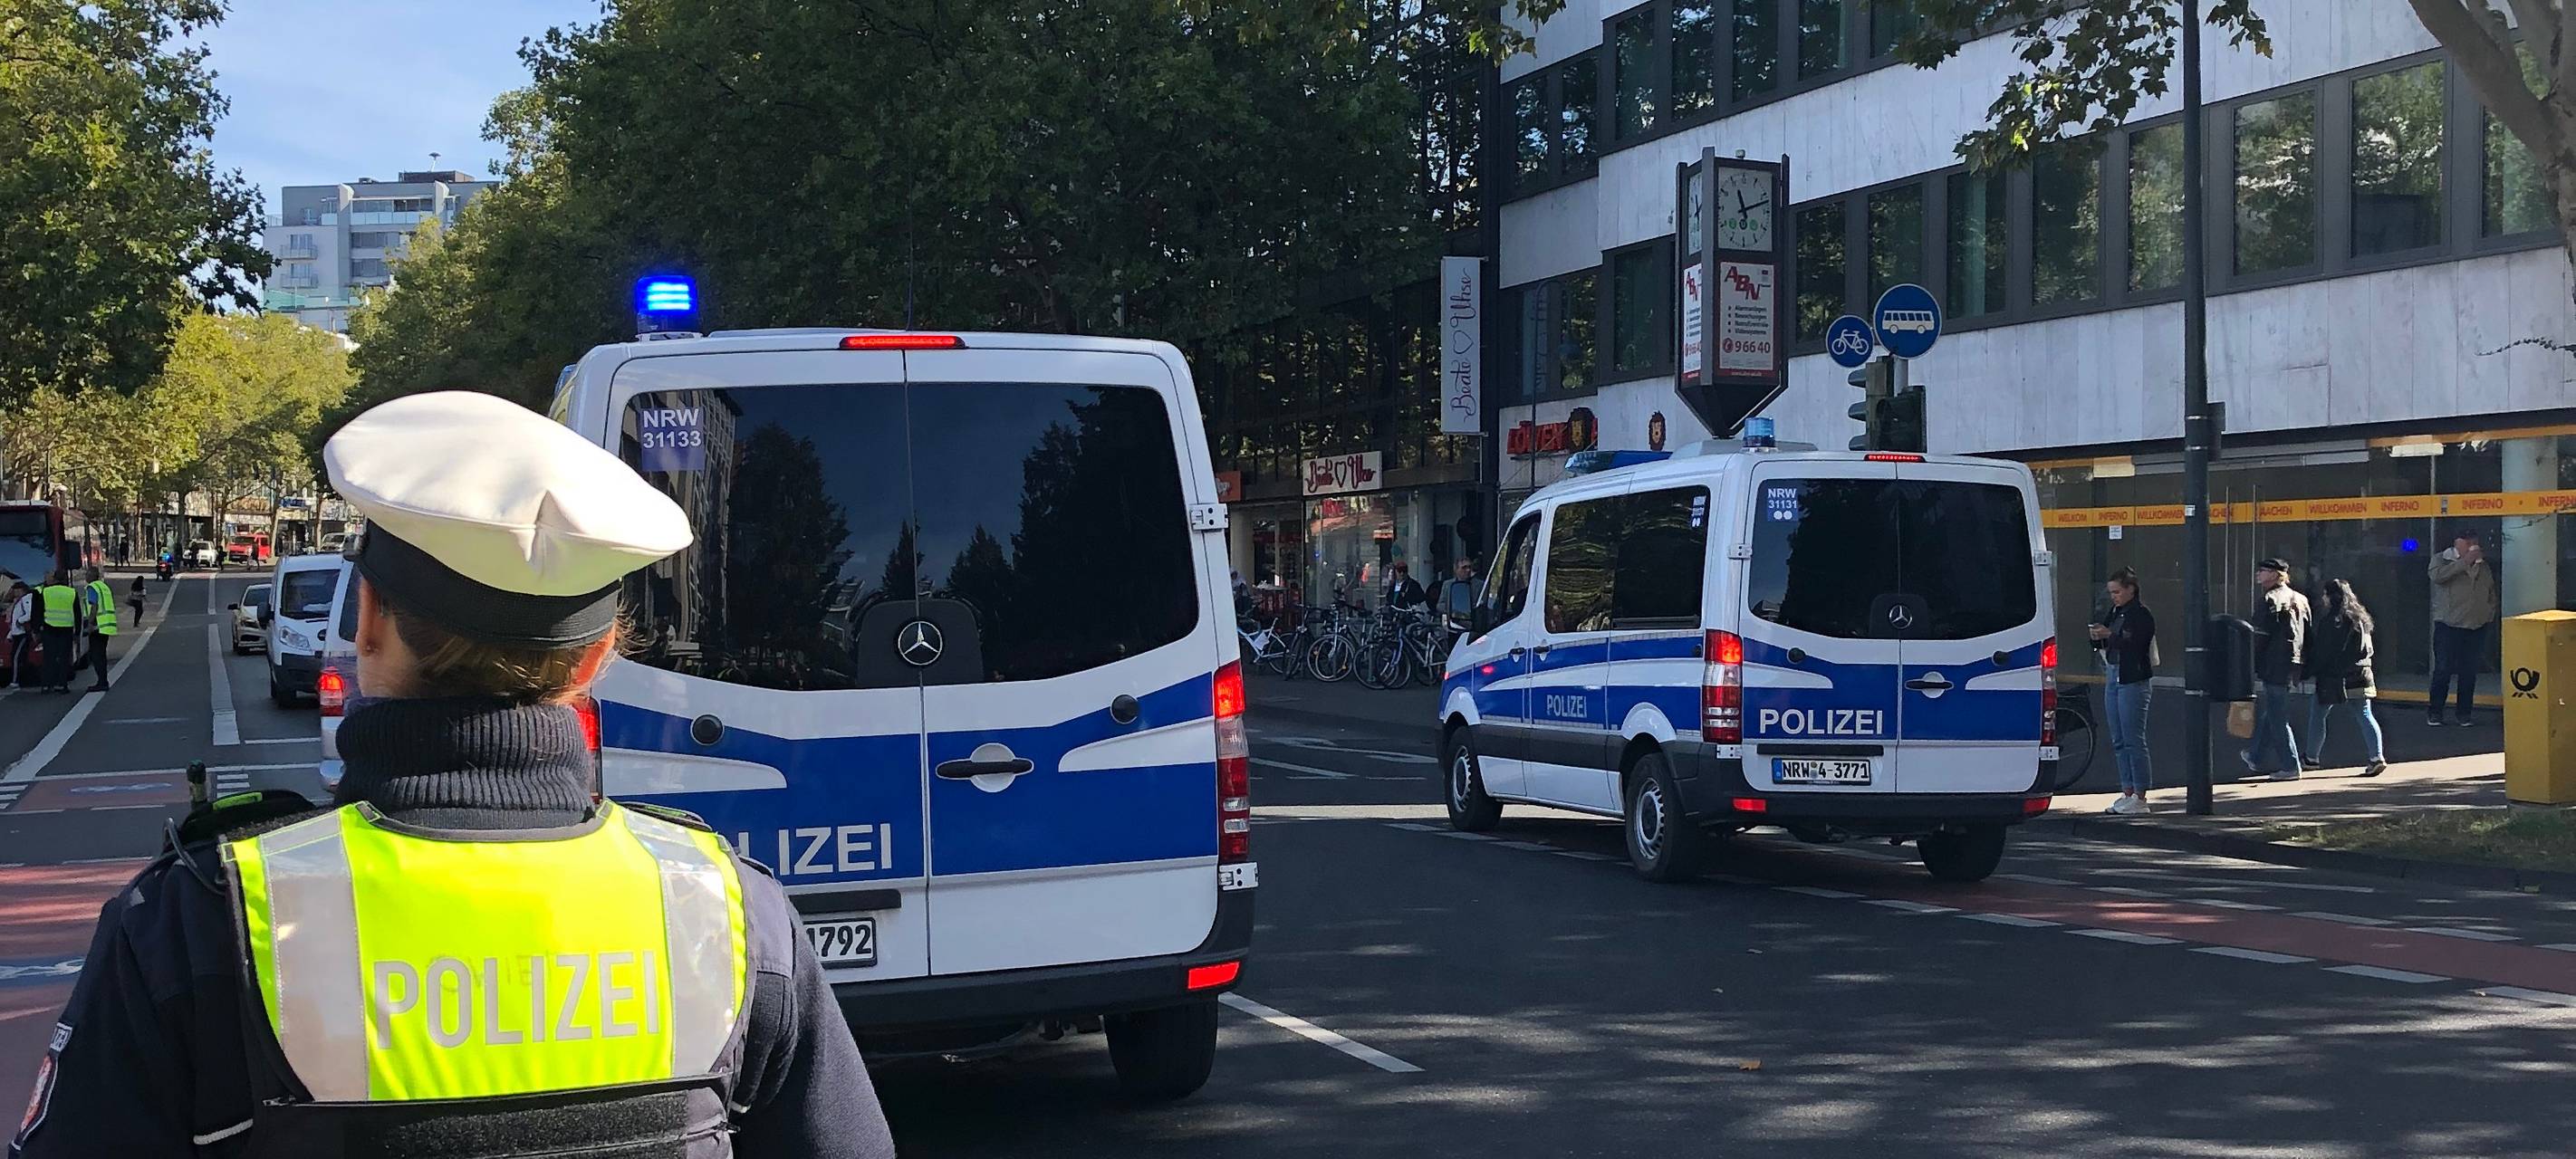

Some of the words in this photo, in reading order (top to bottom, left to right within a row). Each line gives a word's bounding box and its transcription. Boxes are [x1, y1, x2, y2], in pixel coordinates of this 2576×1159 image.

[1724, 265, 1761, 301] ABN
[1450, 267, 1476, 328] Uhse
[1450, 358, 1476, 423] Beate
[643, 408, 699, 428] NRW
[643, 430, 702, 449] 31133
[1767, 488, 1797, 498] NRW
[1767, 500, 1797, 509] 31131
[2310, 502, 2367, 513] WILLKOMMEN
[2380, 501, 2420, 512] INFERNO
[2462, 498, 2504, 510] INFERNO
[1546, 694, 1588, 718] POLIZEI
[1759, 708, 1883, 735] POLIZEI
[1782, 761, 1810, 778] NRW
[1818, 762, 1870, 779] 4-3771
[738, 822, 892, 876] LIZEI
[373, 951, 660, 1050] POLIZEI
